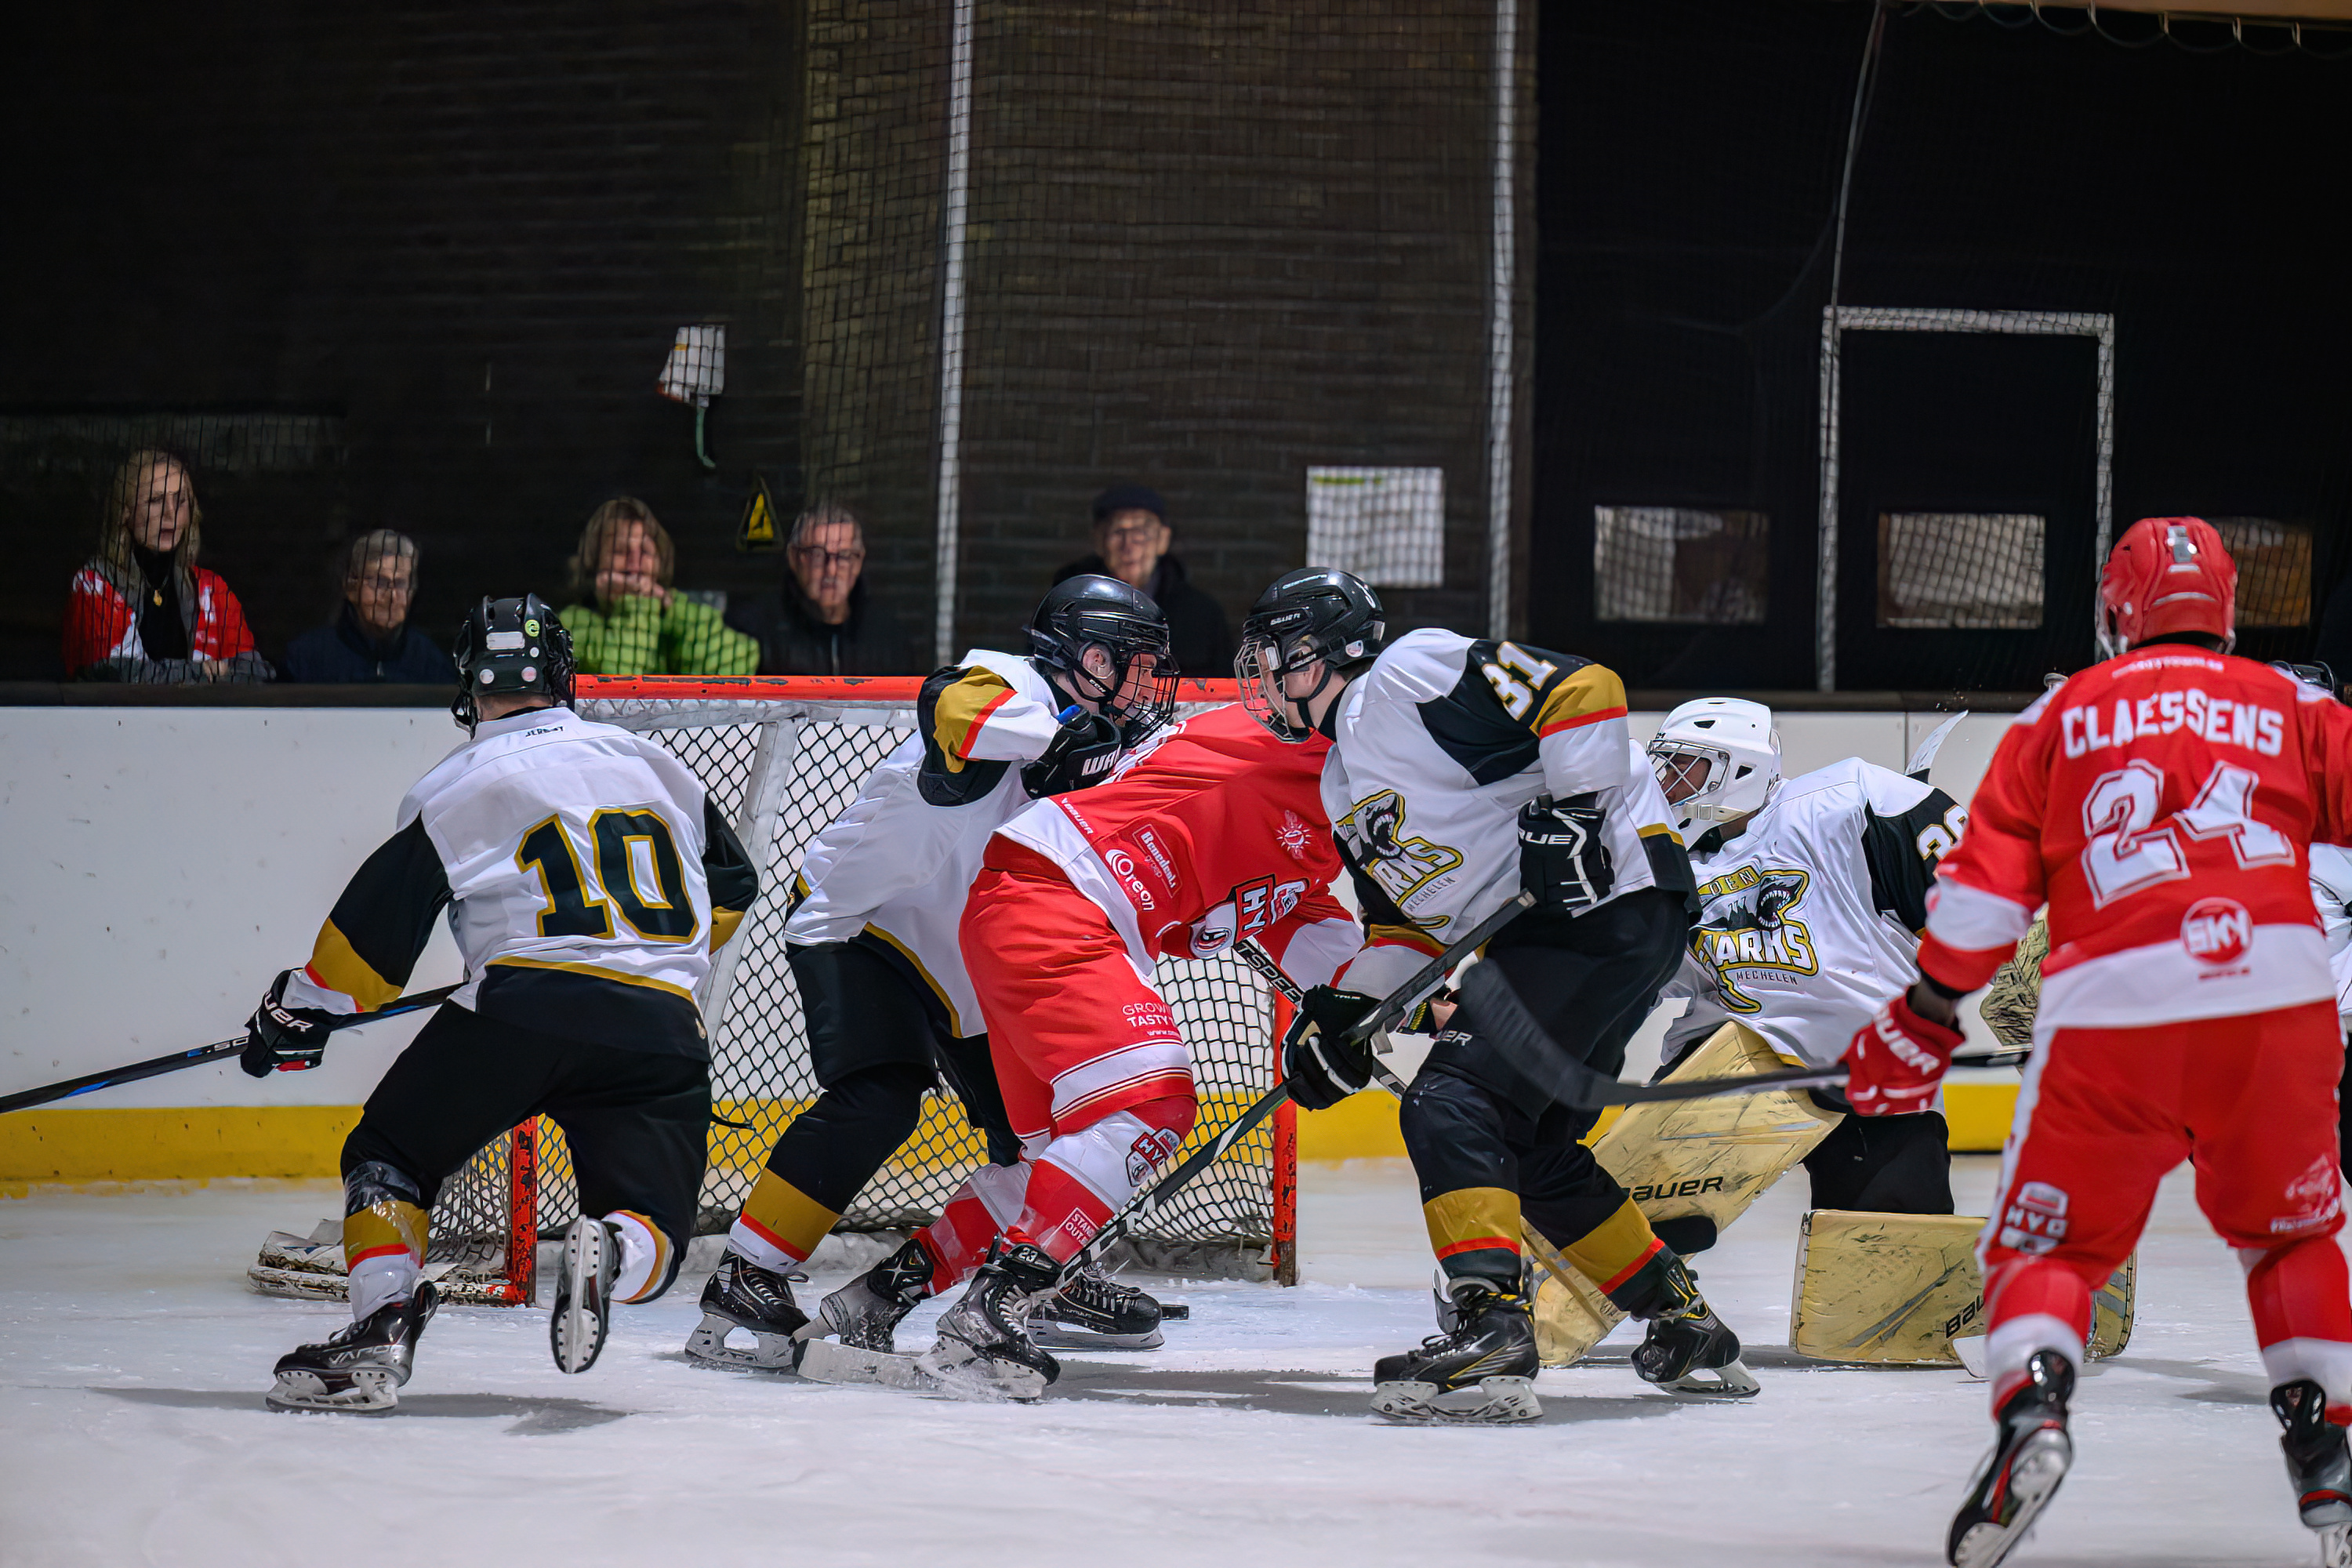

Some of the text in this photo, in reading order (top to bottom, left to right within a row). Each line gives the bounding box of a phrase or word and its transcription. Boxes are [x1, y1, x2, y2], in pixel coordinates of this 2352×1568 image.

[1481, 641, 1558, 720] 31
[2061, 688, 2283, 758] CLAESSENS
[1082, 744, 1121, 776] WA
[2081, 759, 2296, 911] 24
[514, 808, 699, 944] 10
[1406, 876, 1457, 912] MECHELEN
[1243, 887, 1266, 934] HY
[1736, 971, 1798, 985] MECHELEN
[1122, 1002, 1171, 1015] GROW
[1438, 1029, 1473, 1046] ER
[1018, 1247, 1039, 1263] 23
